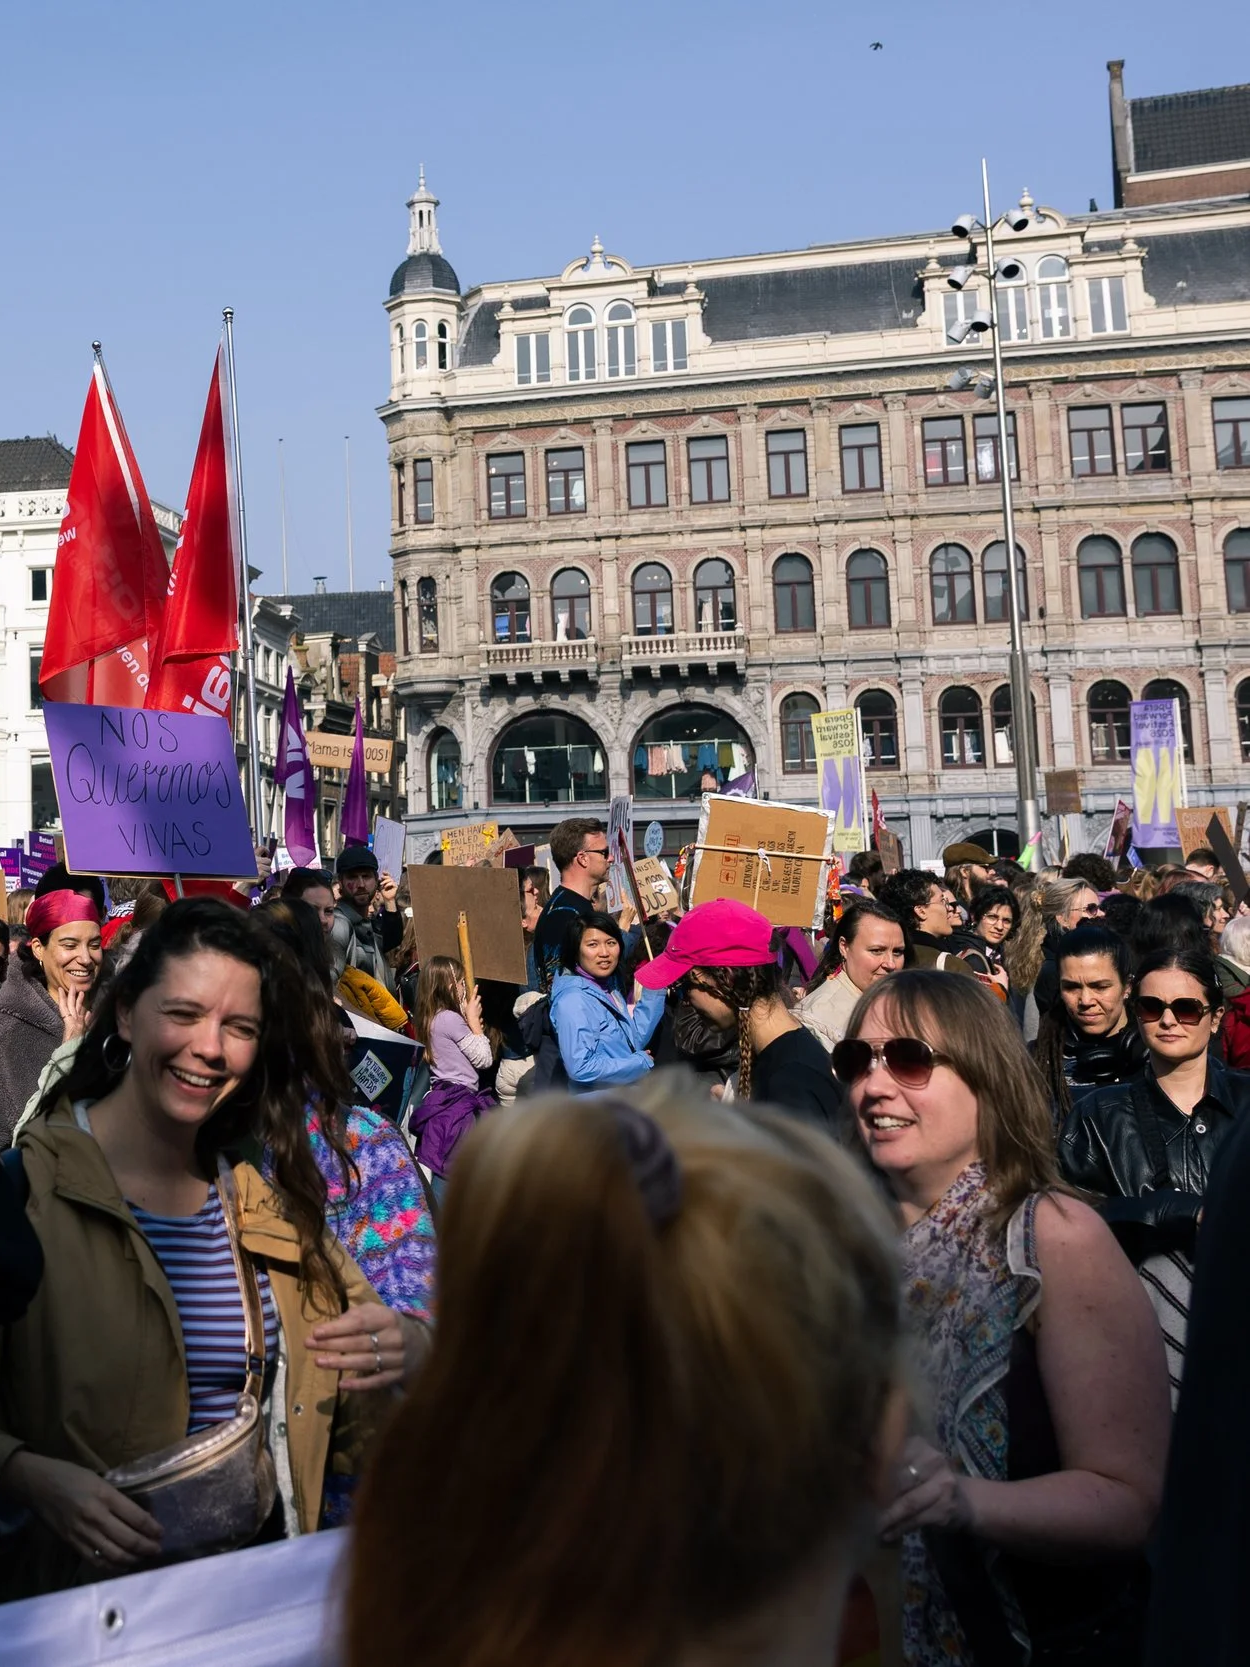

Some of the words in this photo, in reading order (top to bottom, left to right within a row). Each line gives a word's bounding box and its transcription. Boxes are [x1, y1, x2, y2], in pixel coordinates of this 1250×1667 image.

[101, 711, 178, 752] NOS
[306, 740, 339, 757] Mama
[66, 742, 231, 809] Queremos
[118, 821, 212, 859] VIVAS
[447, 829, 464, 839] MEN
[467, 823, 487, 834] HAVE
[450, 835, 478, 847] FAILED
